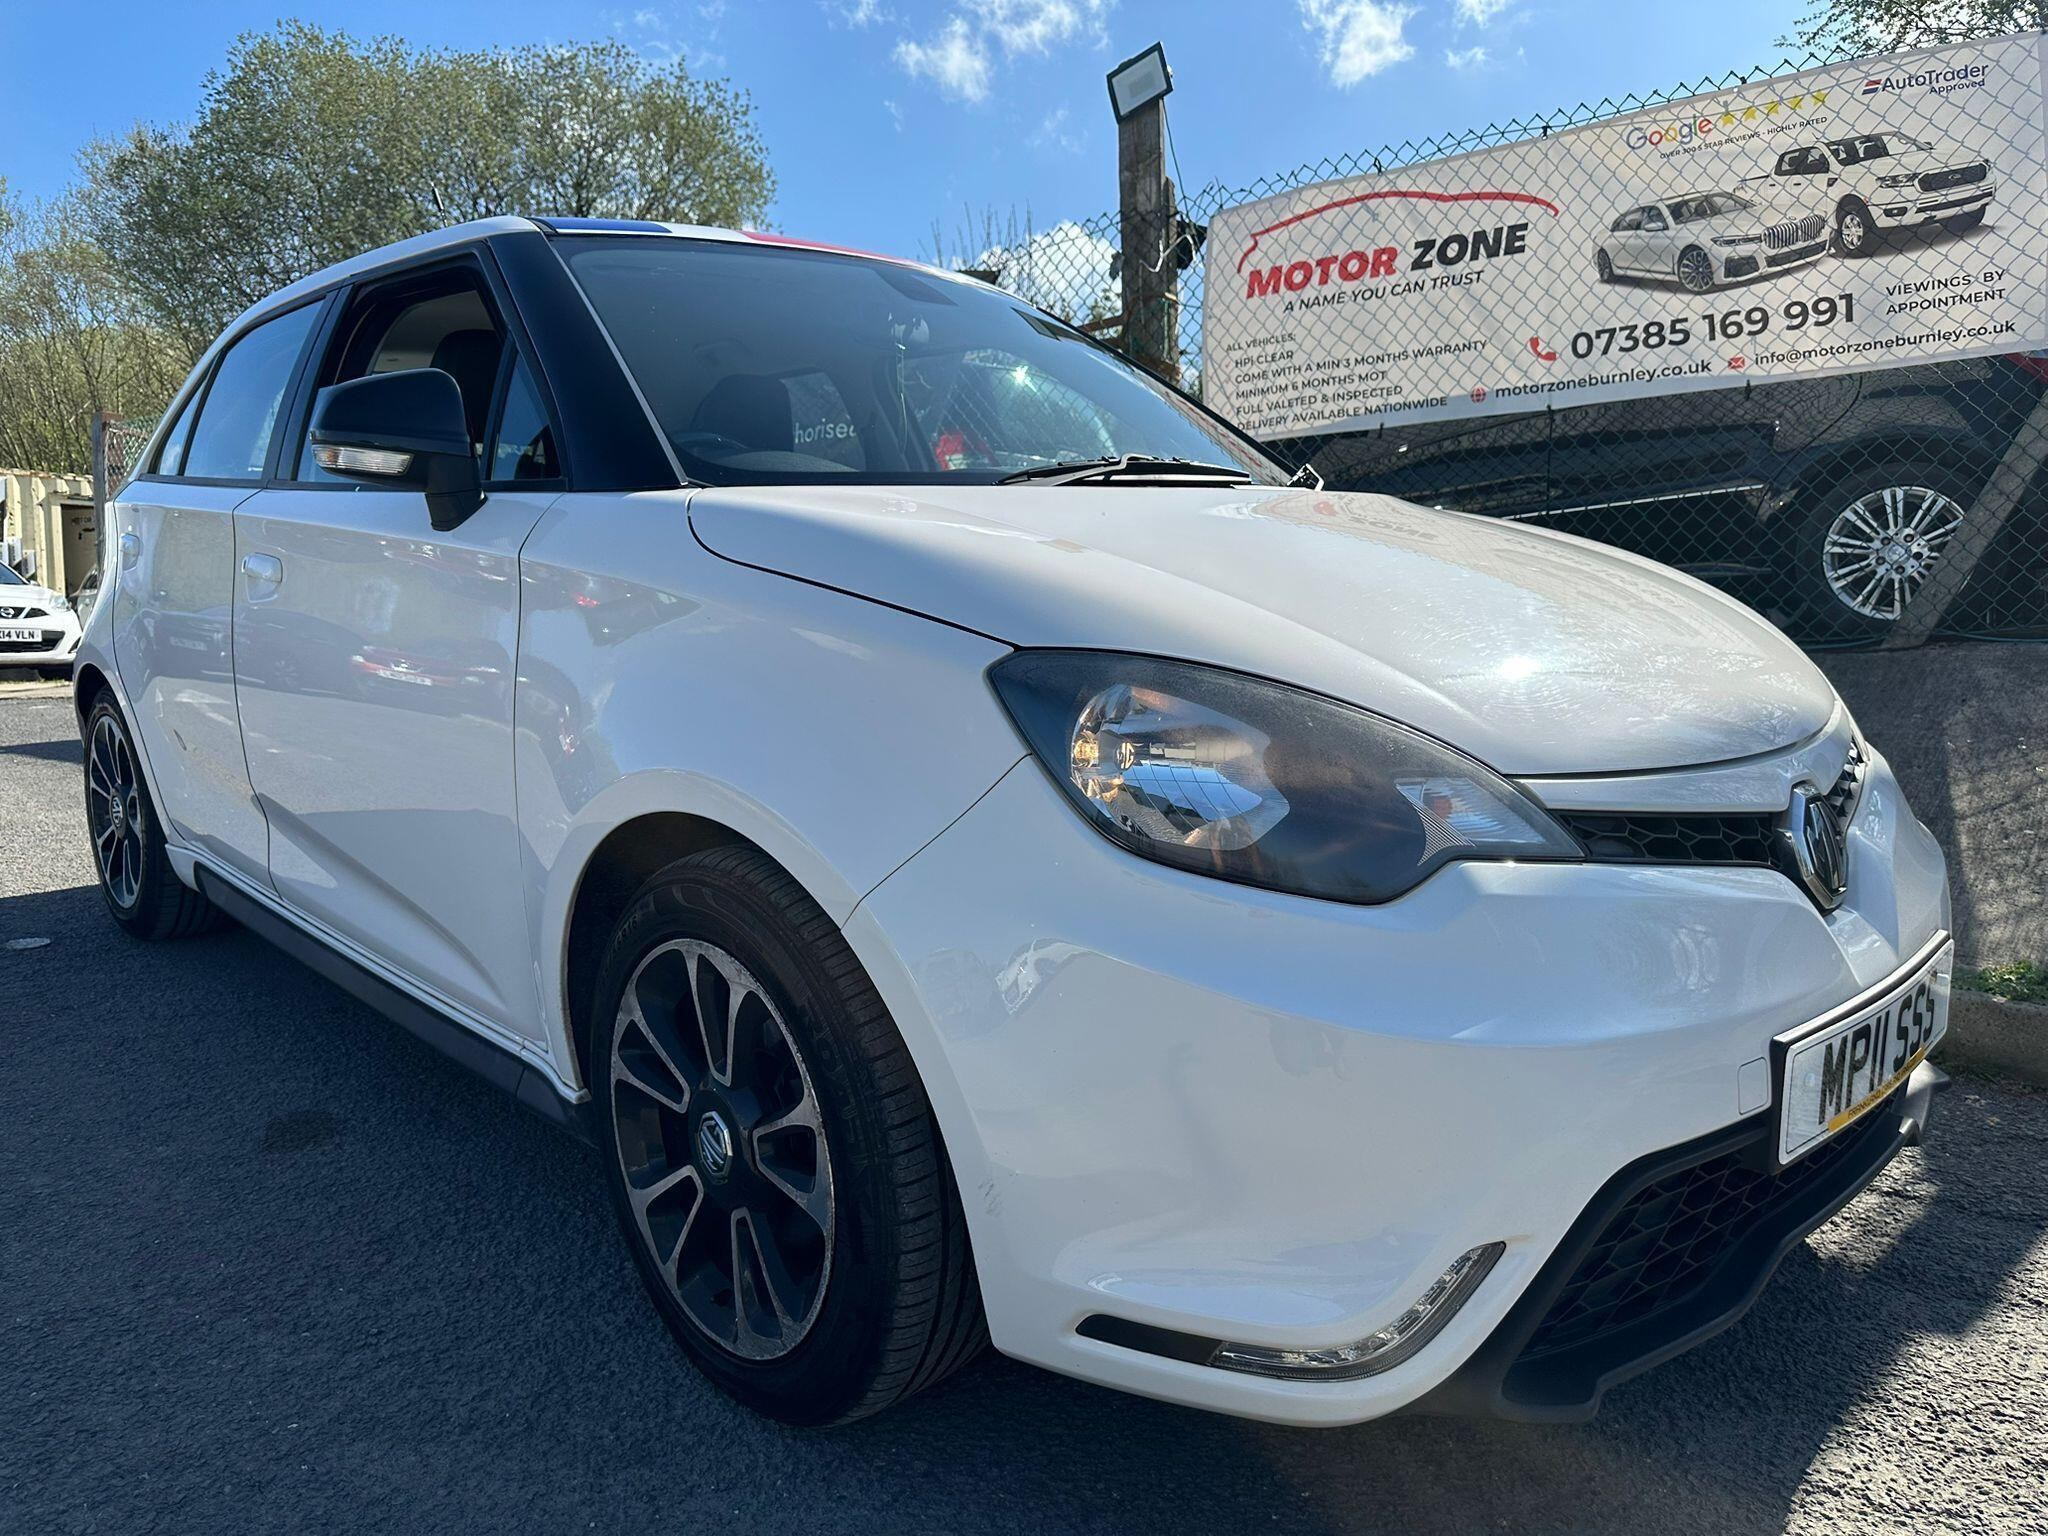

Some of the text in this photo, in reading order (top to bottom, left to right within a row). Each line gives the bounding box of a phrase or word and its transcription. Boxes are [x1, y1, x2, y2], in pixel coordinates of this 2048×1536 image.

[1882, 64, 1989, 92] AutoTrader
[1929, 78, 1985, 95] Approved
[1626, 113, 1714, 150] Google
[1659, 149, 1681, 159] OVER
[1682, 147, 1696, 155] 300
[1704, 139, 1723, 149] STAR
[1725, 130, 1761, 145] REVIEWS
[1767, 122, 1798, 135] HIGHLY
[1800, 116, 1828, 128] RATED
[1246, 222, 1529, 299] MOTOR ZONE
[1283, 270, 1485, 313] A NAME YOU CAN TRUST
[1886, 269, 2006, 296] VIEWINGS BY
[1886, 288, 2007, 315] APPOINTMENT
[1226, 332, 1297, 352] ALL VEHICLES:
[1571, 292, 1854, 359] 07385 169 991
[1755, 320, 2016, 366] info@motorzoneburnley.co.uk
[1236, 339, 1487, 385] COME WITH A MIN 3 MONTHS WARRANTY
[1257, 350, 1294, 365] CLEAR
[1236, 370, 1388, 400] MINIMUM 6 MONTHS MOT
[1495, 359, 1712, 398] motorzoneburnley.co.uk
[1236, 385, 1403, 416] FULL VALETED & INSPECTED
[1237, 396, 1448, 431] DELIVERY AVAILABLE NATIONWIDE
[1818, 1009, 1891, 1126] MP11
